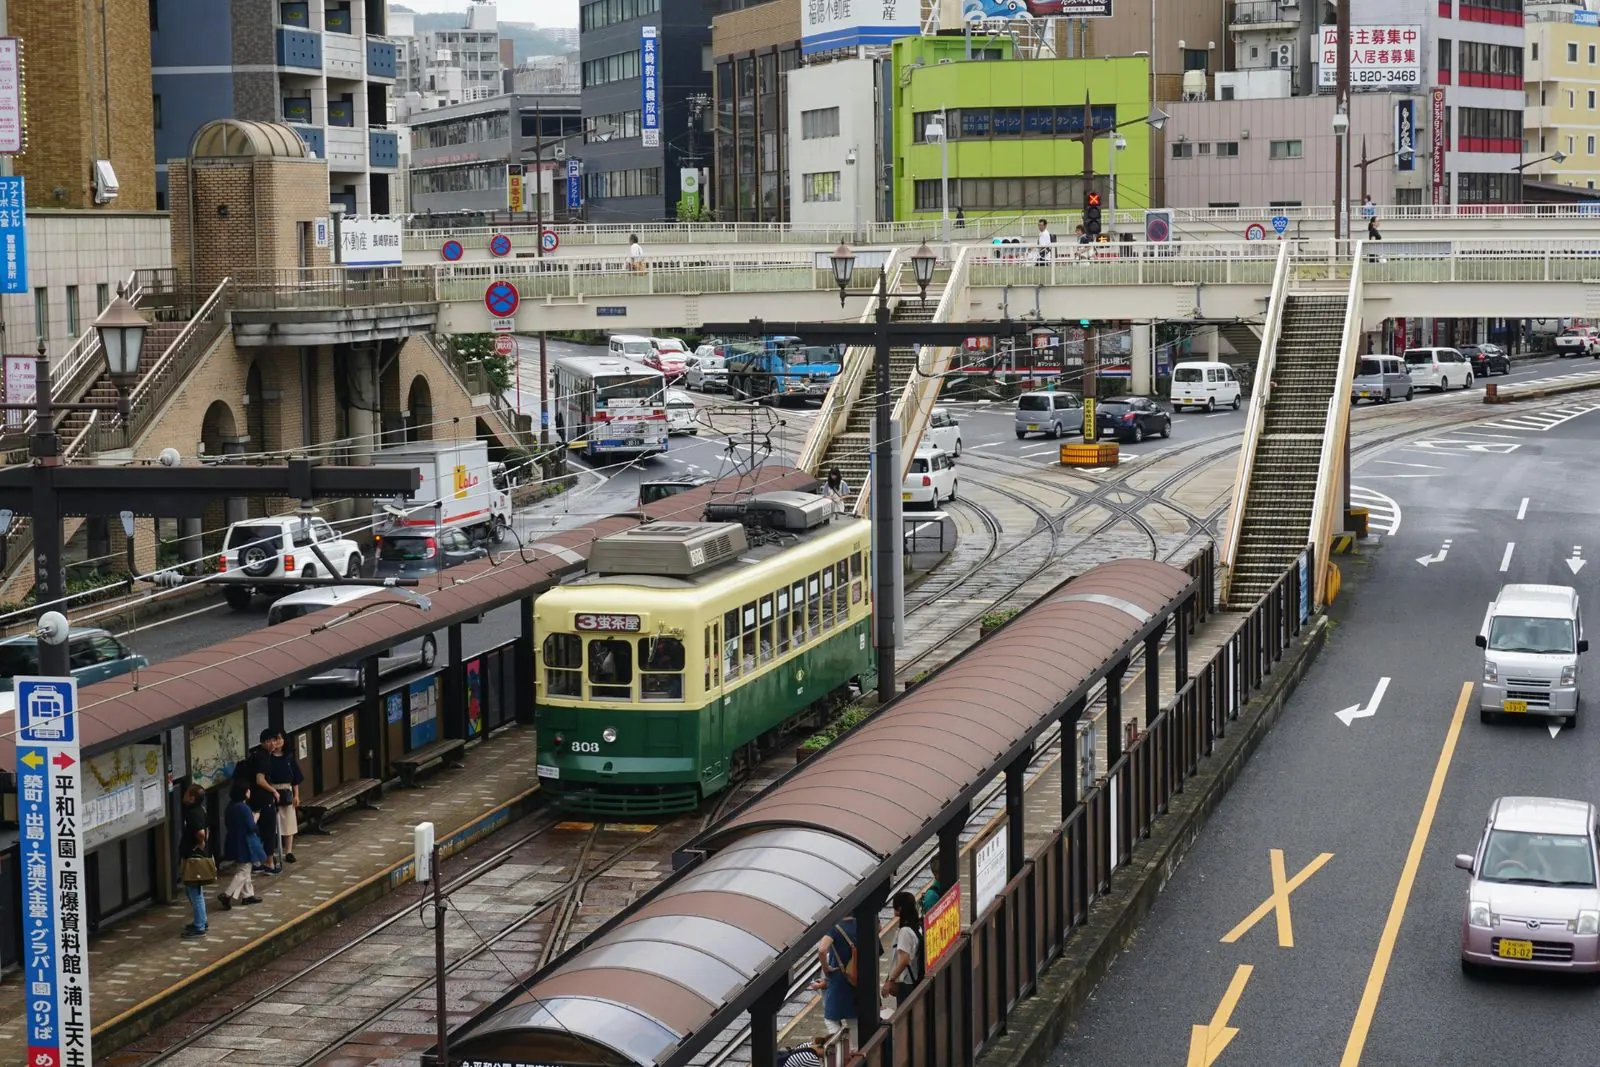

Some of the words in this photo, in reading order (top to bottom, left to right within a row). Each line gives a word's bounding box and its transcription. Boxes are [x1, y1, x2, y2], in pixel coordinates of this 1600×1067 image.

[1324, 49, 1416, 64] 店入居者募集
[644, 39, 656, 126] 長崎教員養成塾
[1359, 70, 1416, 82] 820-3468
[578, 615, 597, 629] 3
